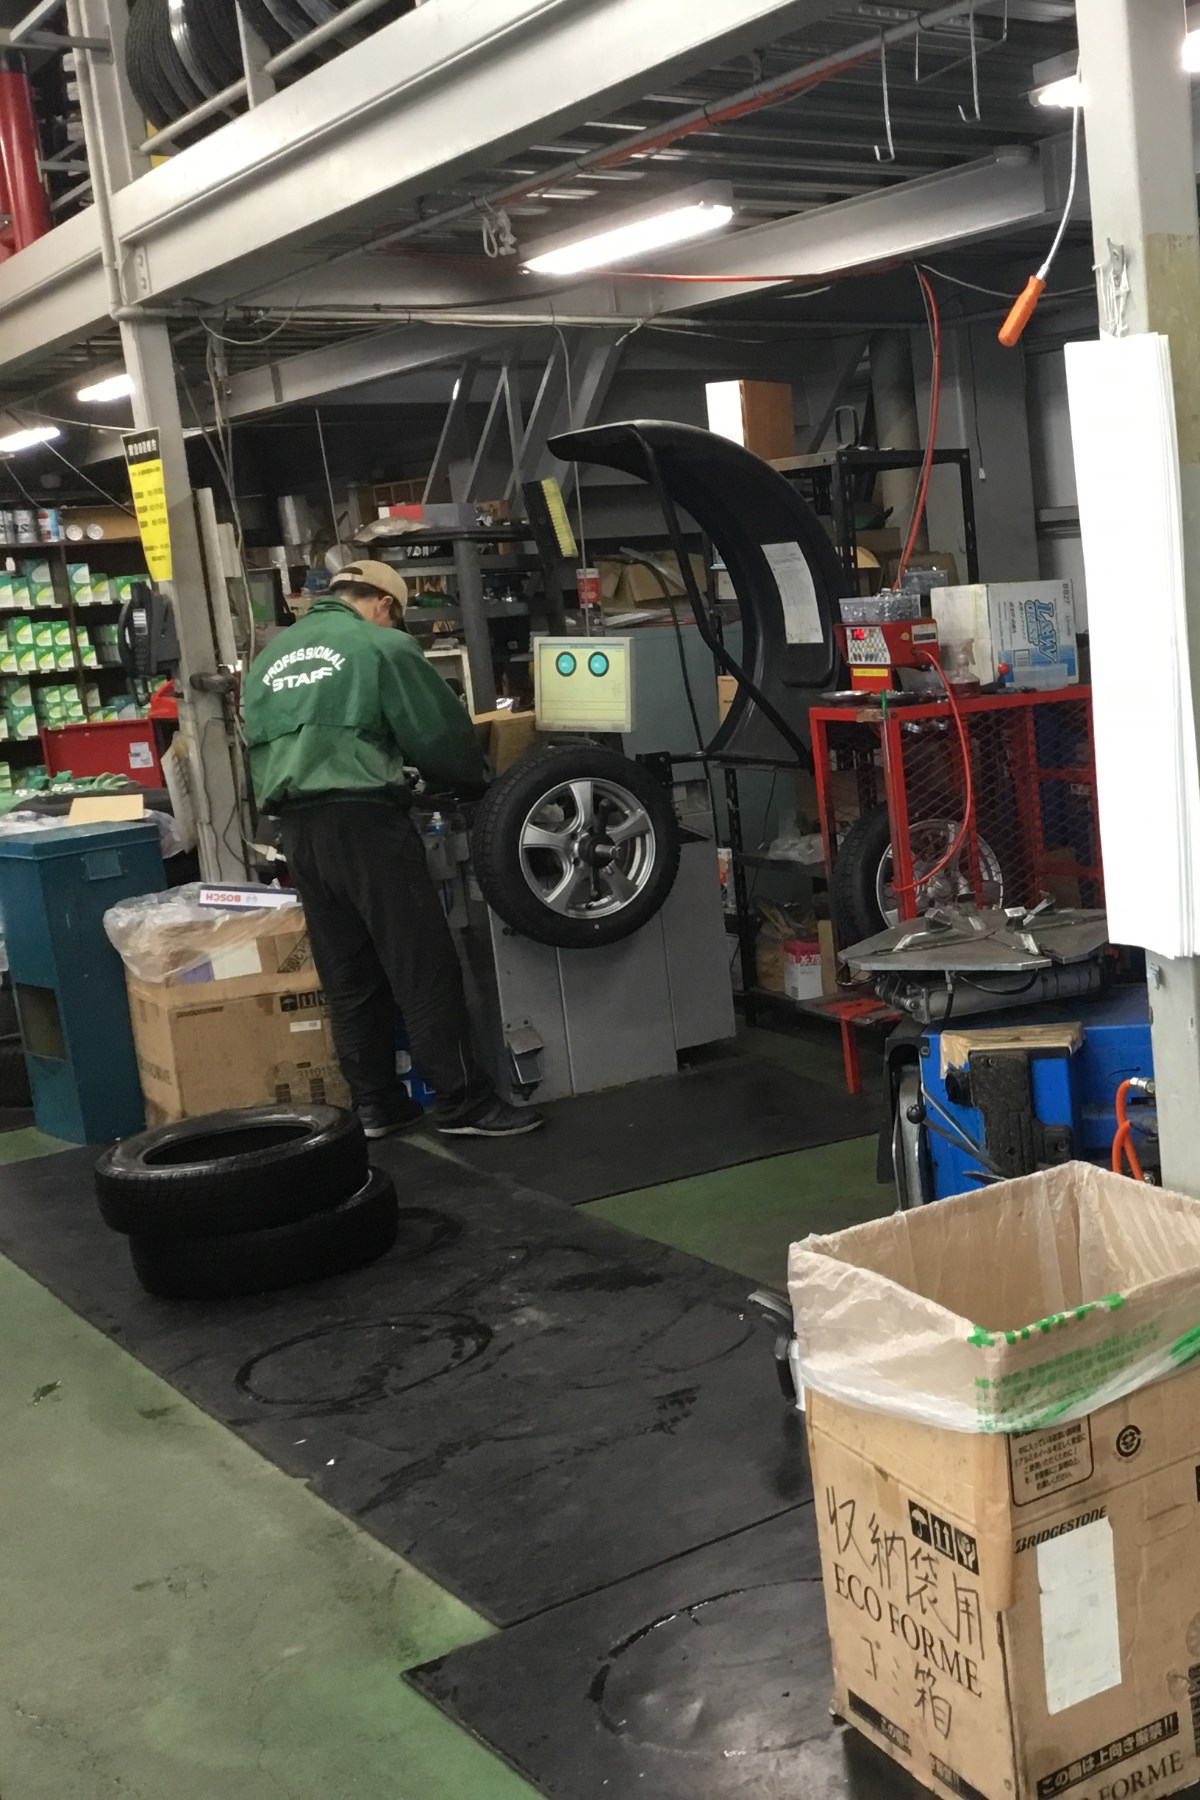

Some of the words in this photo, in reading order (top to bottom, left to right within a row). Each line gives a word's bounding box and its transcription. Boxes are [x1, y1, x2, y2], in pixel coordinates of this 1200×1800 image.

[262, 645, 346, 687] PROFESSIONAL
[272, 666, 333, 693] STAFF
[205, 893, 241, 903] BOSCH
[1014, 1505, 1108, 1554] BRIDGESTONE
[826, 1486, 986, 1661] 収納袋用
[833, 1562, 882, 1623] ECO
[888, 1602, 983, 1698] FORME
